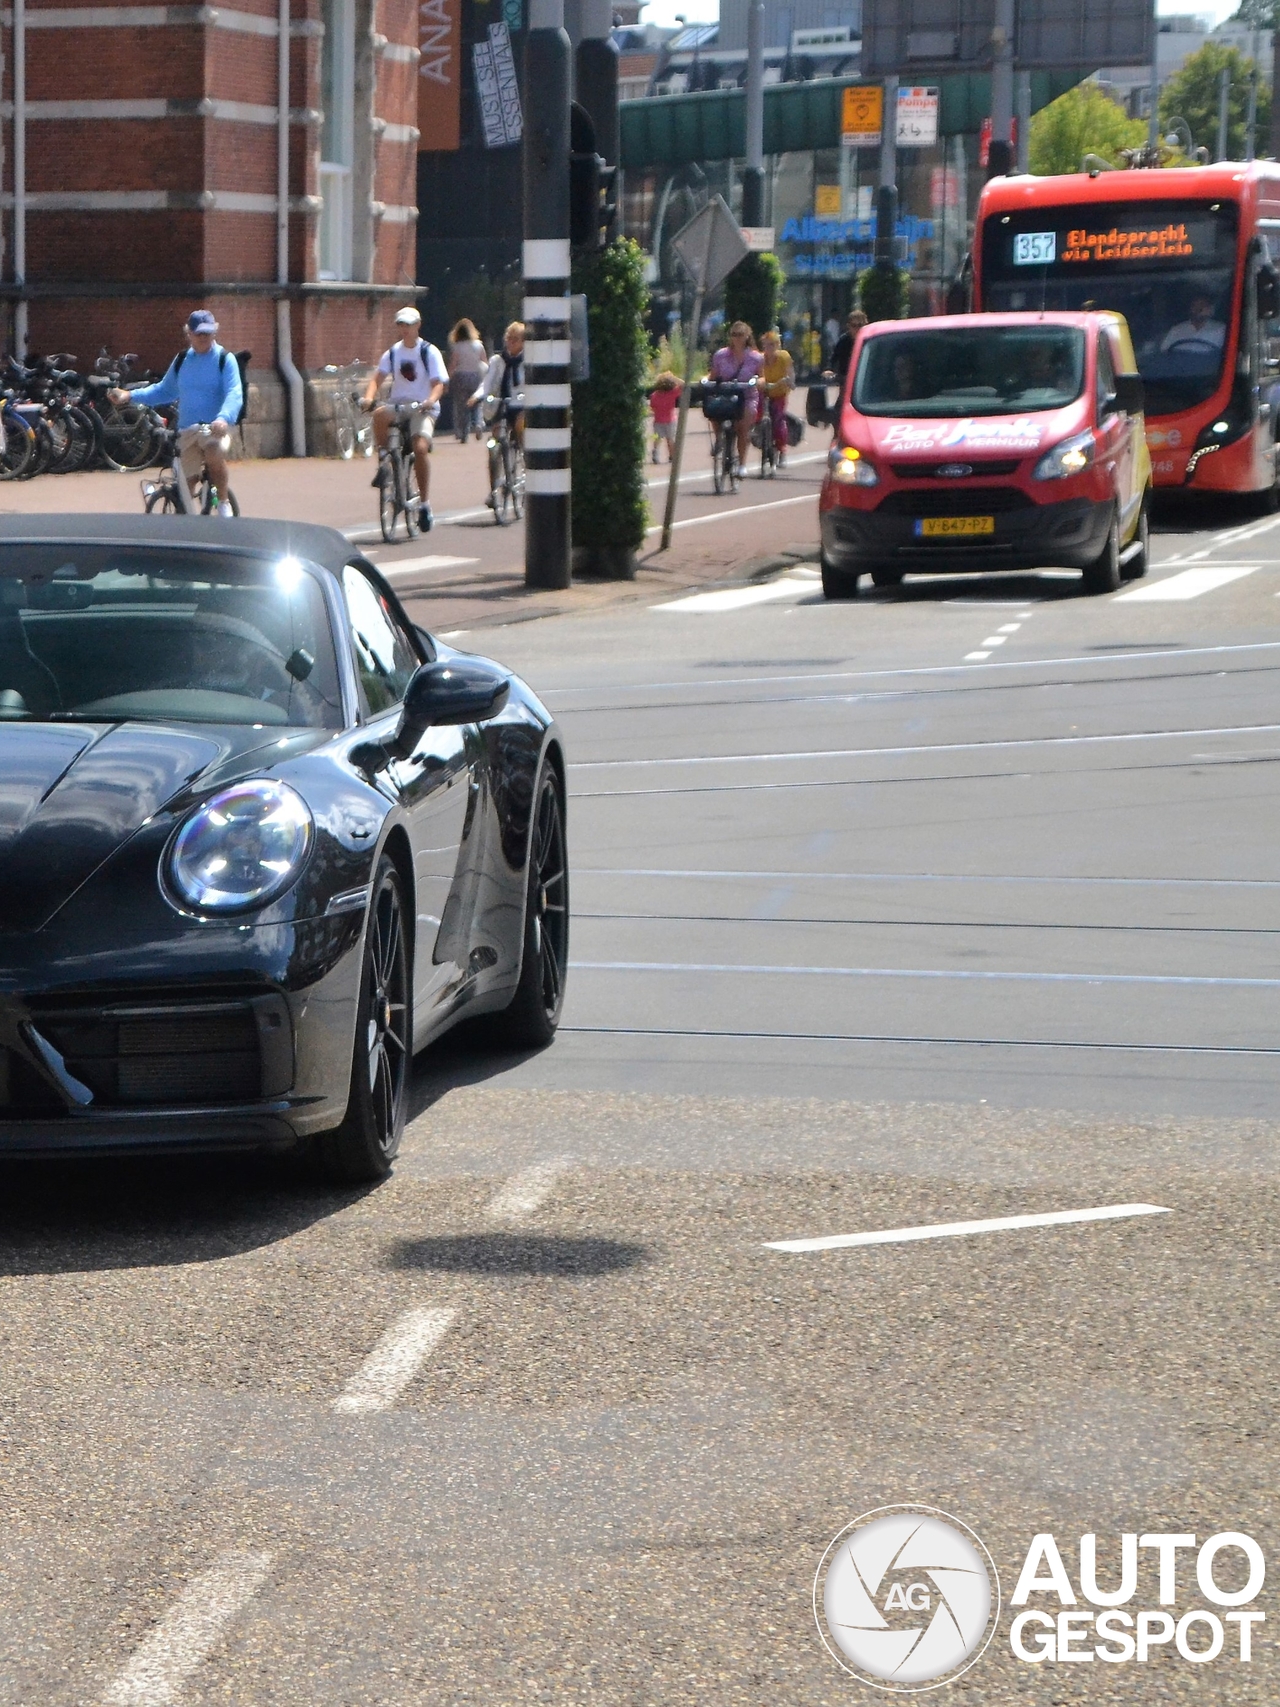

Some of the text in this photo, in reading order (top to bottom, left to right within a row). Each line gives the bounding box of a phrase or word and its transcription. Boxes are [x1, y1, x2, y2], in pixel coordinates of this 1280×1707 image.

[475, 42, 504, 146] MUST-SEE
[492, 23, 521, 141] ESSENTIALS
[1019, 234, 1054, 260] 357
[1061, 249, 1090, 263] via
[893, 437, 1041, 451] AUTO VERHUUR
